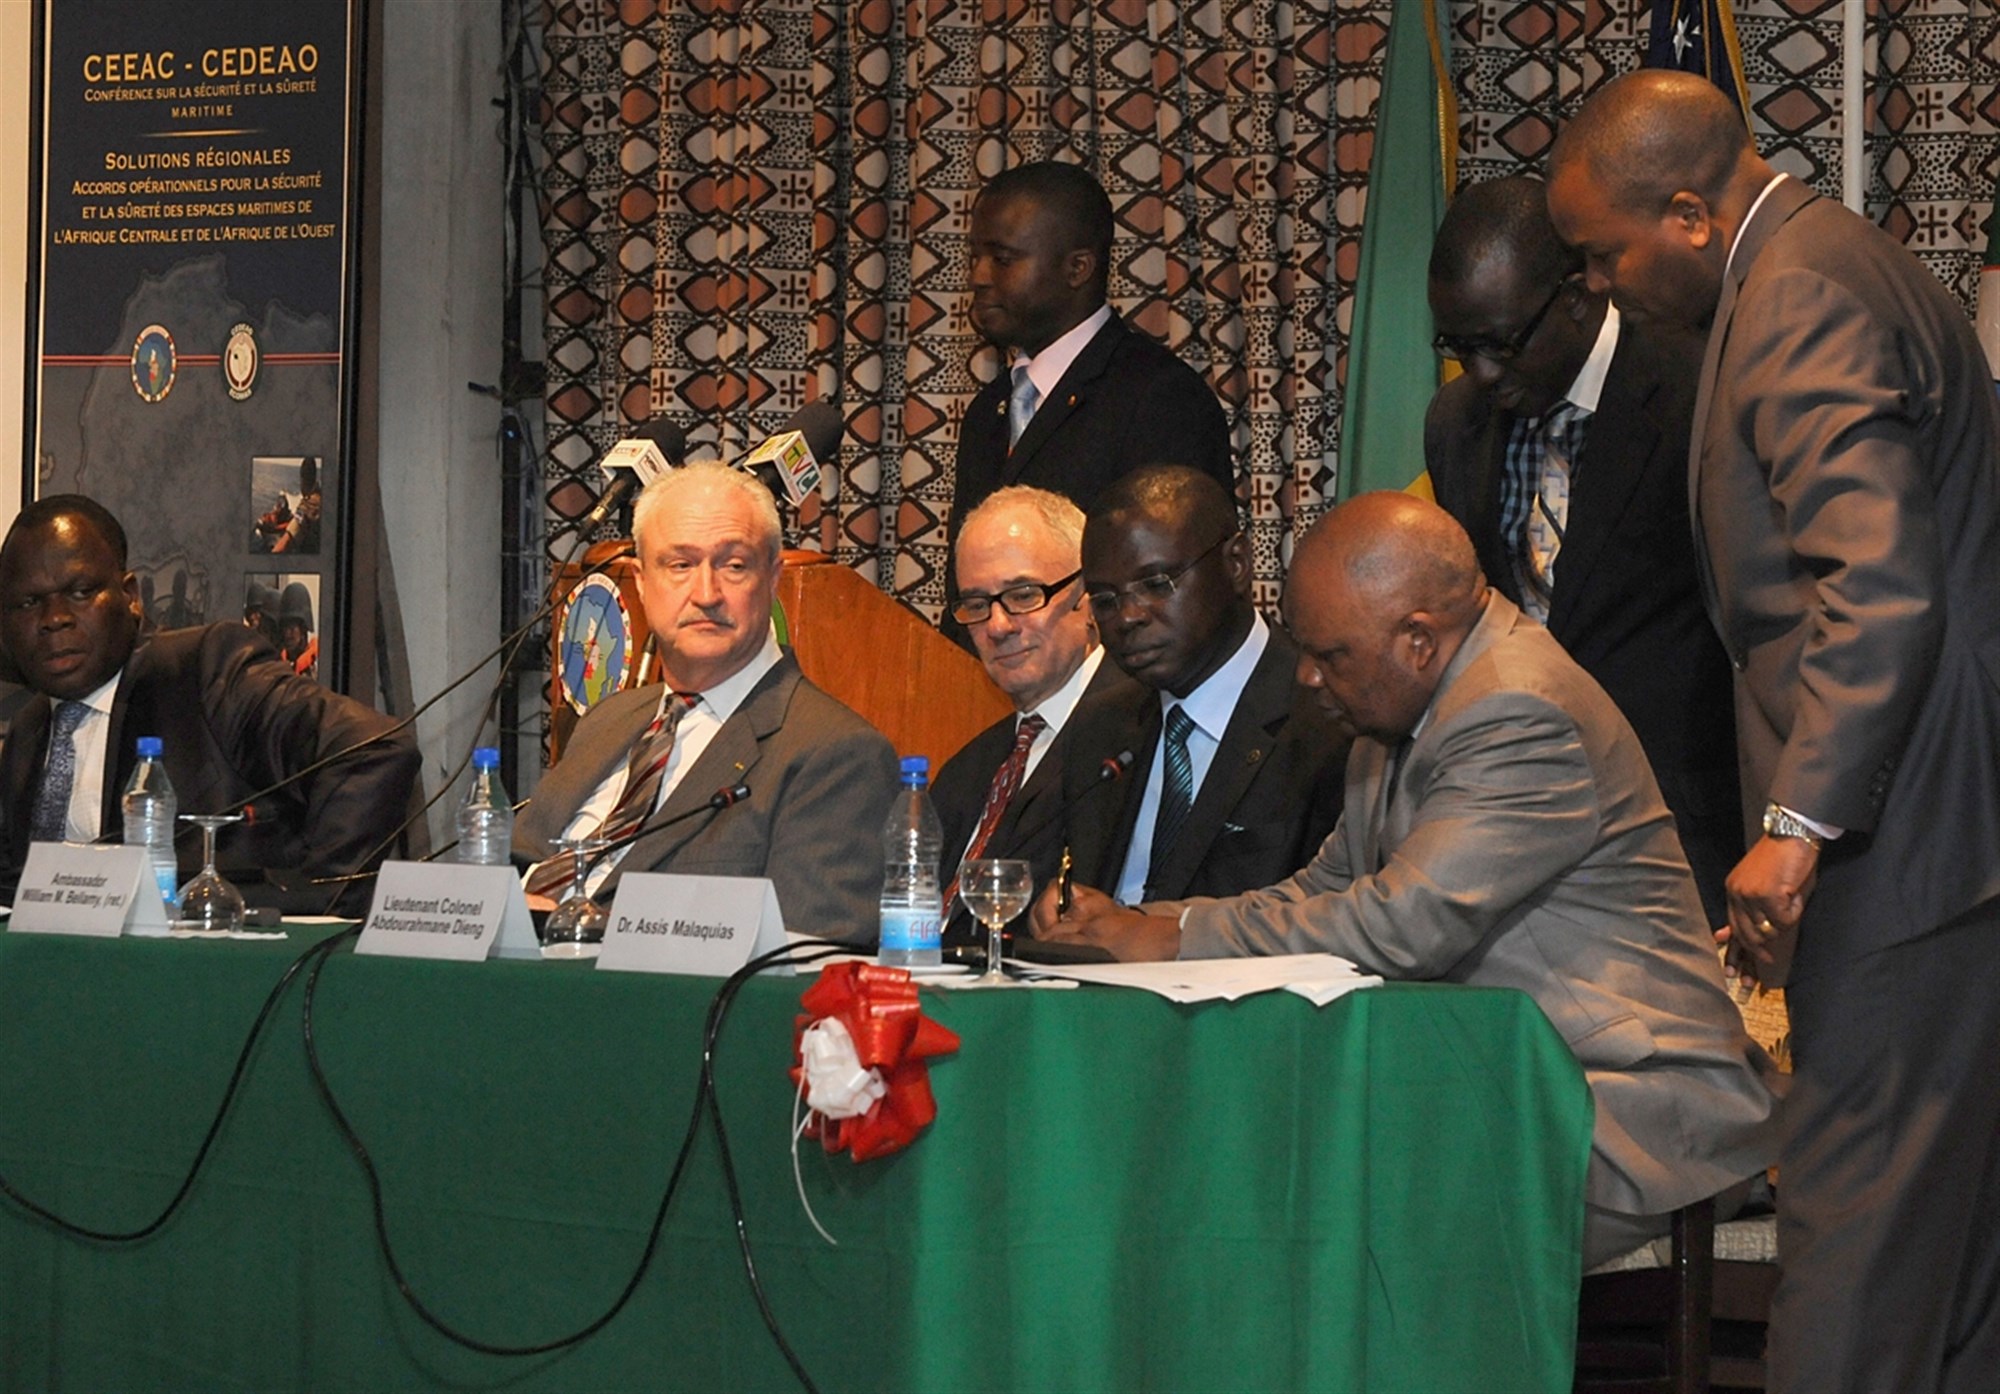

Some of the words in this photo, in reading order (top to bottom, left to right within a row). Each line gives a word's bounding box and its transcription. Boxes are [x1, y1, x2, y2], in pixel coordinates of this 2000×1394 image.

[83, 51, 175, 83] CEEAC
[202, 44, 319, 78] CEDEAO
[156, 87, 177, 99] SUR
[179, 86, 192, 98] LA
[194, 81, 242, 97] SÉCURITÉ
[244, 83, 257, 95] ET
[260, 82, 274, 94] LA
[276, 78, 318, 93] SÛRETÉ
[171, 104, 233, 118] MARITIME
[196, 146, 292, 168] RÉGIONALES
[129, 176, 218, 194] OPÉRATIONNELS
[220, 177, 252, 191] POUR
[254, 176, 270, 190] LA
[271, 170, 322, 190] SÉCURITÉ
[82, 206, 97, 219] ET
[100, 206, 115, 219] LA
[117, 201, 162, 219] SÛRETÉ
[163, 204, 184, 217] DES
[186, 202, 236, 217] ESPACES
[237, 200, 296, 216] MARITIMES
[297, 200, 313, 213] DE
[181, 228, 195, 242] ET
[196, 228, 212, 241] DE
[274, 225, 289, 239] DE
[51, 872, 109, 888] Ambassador
[54, 888, 64, 903] M.
[383, 895, 440, 914] Lieutenant
[441, 897, 484, 916] Colonel
[369, 914, 451, 934] Abdourahmane
[452, 918, 485, 940] Dieng
[616, 916, 633, 934] Dr.
[634, 918, 669, 936] Assis
[671, 919, 736, 943] Malaquias
